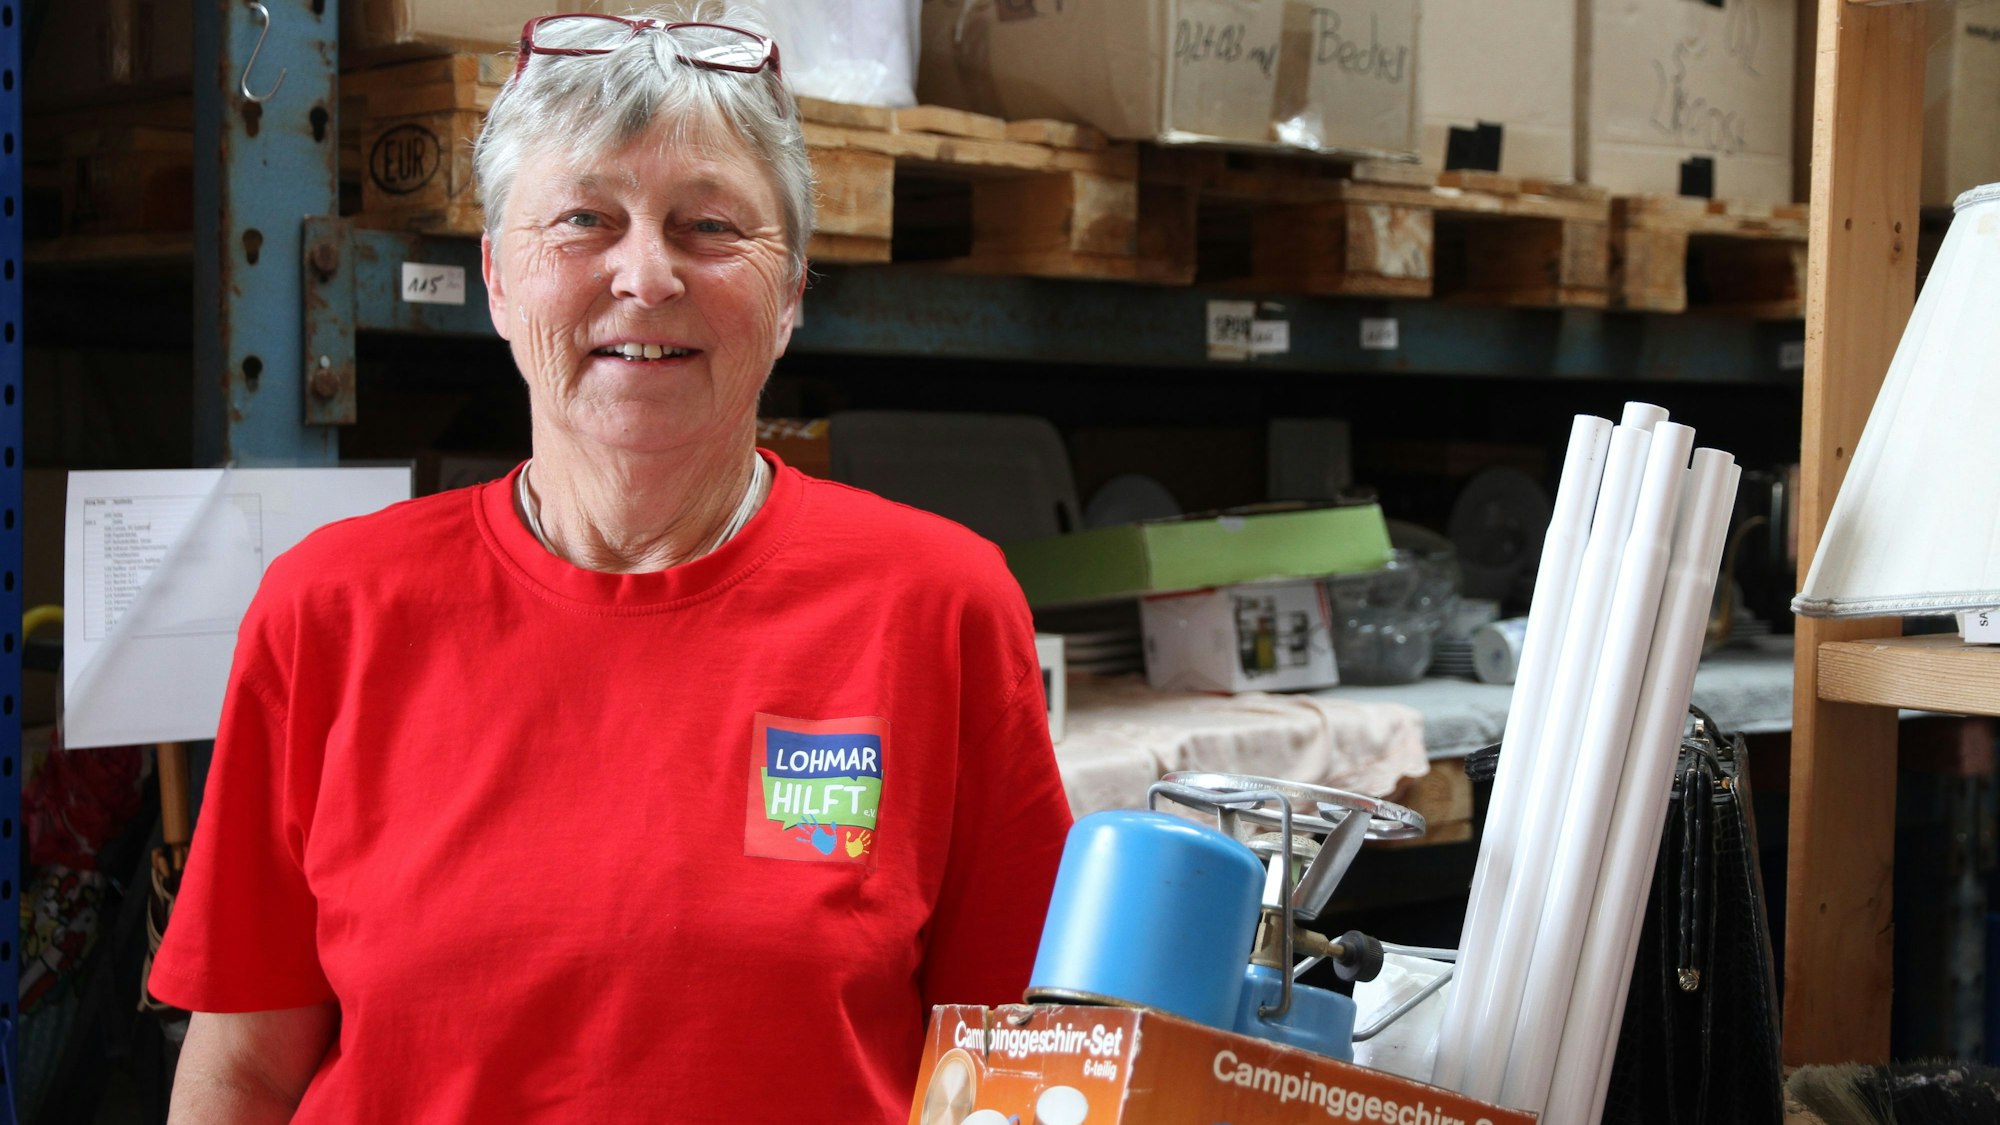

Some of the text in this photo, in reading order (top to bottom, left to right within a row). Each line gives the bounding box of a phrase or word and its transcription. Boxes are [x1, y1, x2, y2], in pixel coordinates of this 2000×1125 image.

[383, 137, 425, 183] EUR
[776, 747, 877, 773] LOHMAR
[771, 781, 866, 814] HILFT
[954, 1020, 1123, 1058] Campinggeschirr-Set
[1083, 1058, 1118, 1081] 6-teilig
